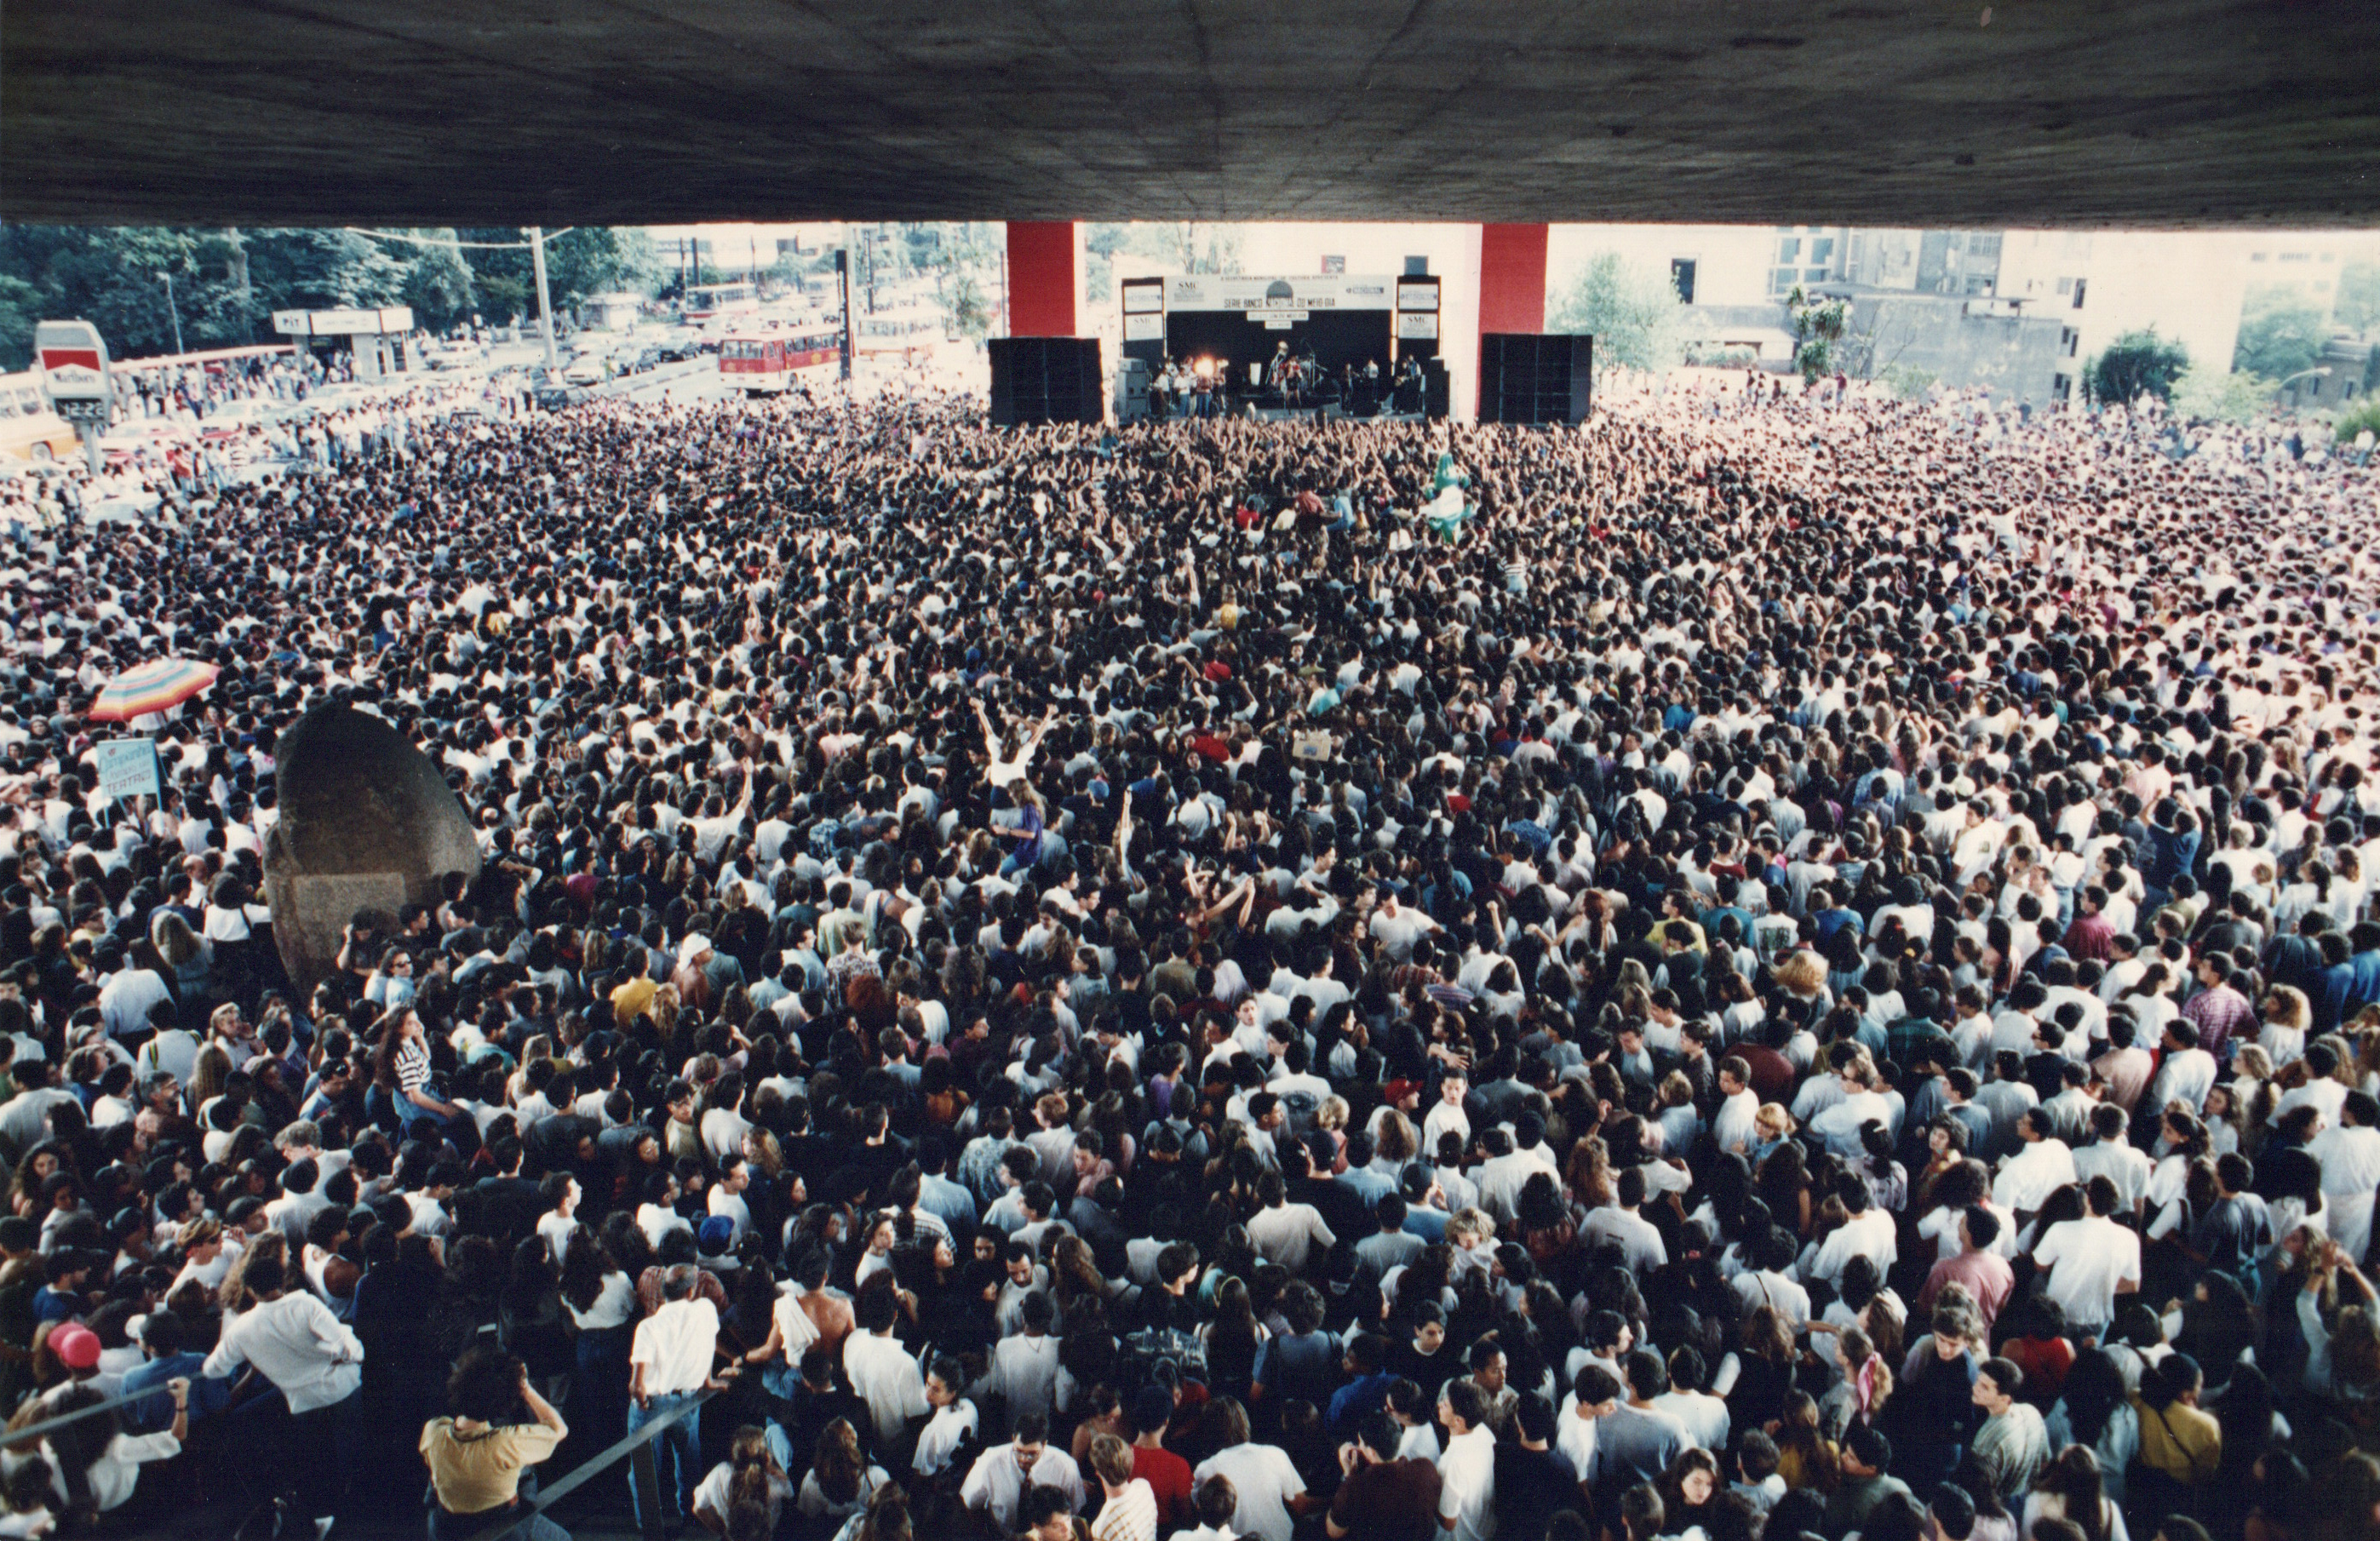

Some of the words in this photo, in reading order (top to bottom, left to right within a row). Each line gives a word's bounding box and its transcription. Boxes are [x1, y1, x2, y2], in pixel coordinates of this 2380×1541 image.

[1179, 282, 1198, 290] SMC
[1243, 298, 1263, 308] BANCO
[1407, 316, 1429, 324] SMC
[54, 369, 95, 383] Marlboro
